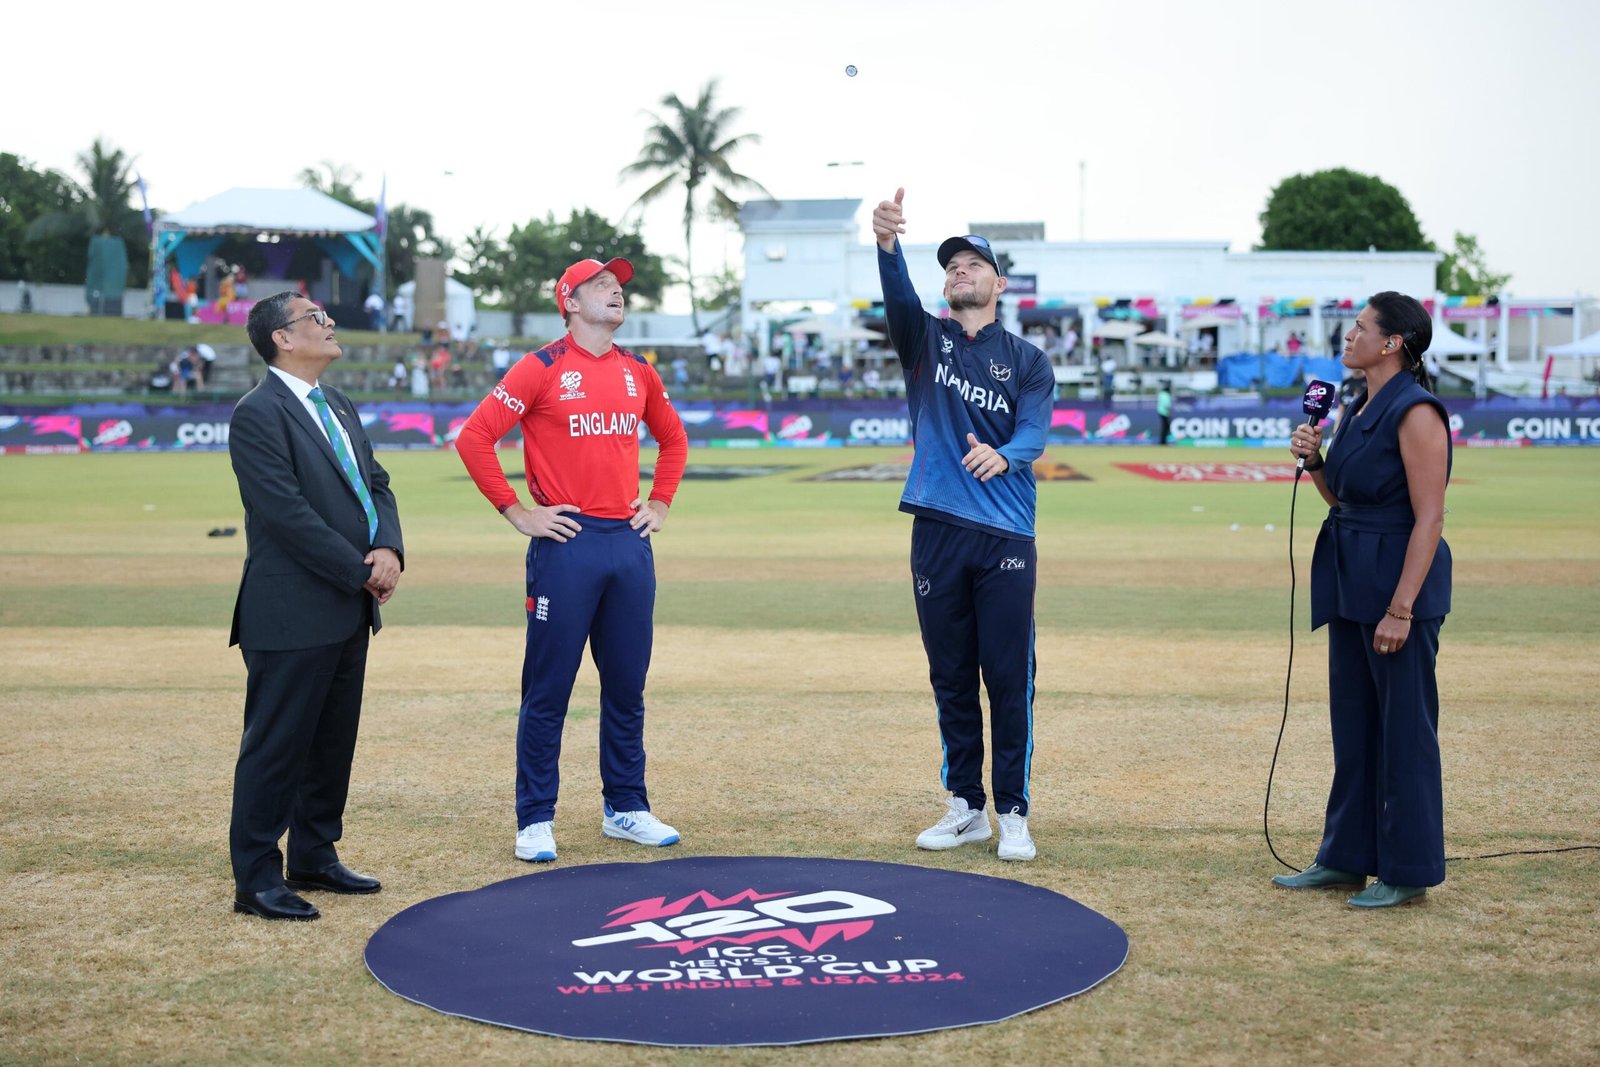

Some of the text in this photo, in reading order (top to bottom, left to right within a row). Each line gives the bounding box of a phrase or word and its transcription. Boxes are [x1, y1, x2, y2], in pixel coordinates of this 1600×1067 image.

[492, 385, 526, 415] cinch
[569, 412, 637, 437] ENGLAND
[850, 418, 909, 439] COIN
[1169, 417, 1292, 438] COIN TOSS
[1507, 417, 1571, 439] COIN
[669, 954, 838, 968] MEN'S T20
[707, 945, 791, 958] ICC
[556, 971, 966, 995] WEST INDIES & USA 2024
[573, 959, 939, 985] WORLD CUP
